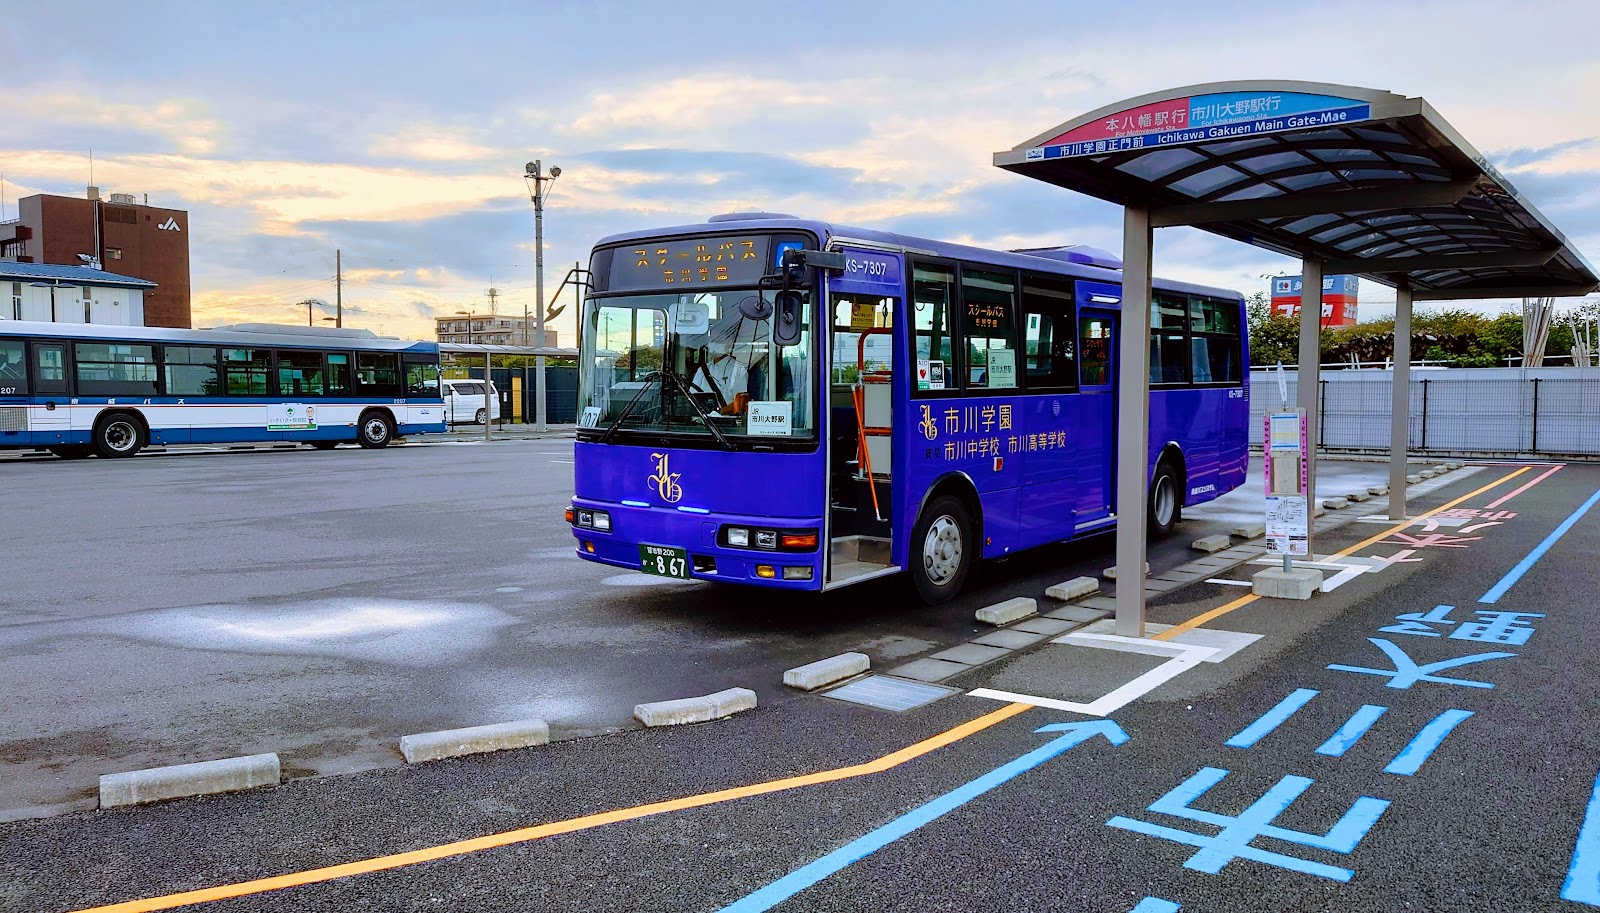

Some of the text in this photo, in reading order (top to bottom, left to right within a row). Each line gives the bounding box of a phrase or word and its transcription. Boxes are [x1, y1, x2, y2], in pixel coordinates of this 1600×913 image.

[1105, 109, 1186, 132] 本八幡駅行
[1191, 95, 1281, 121] 市川大野駅行
[1059, 136, 1144, 156] 市川学園正門前
[1158, 131, 1205, 144] Ichikawa
[1208, 124, 1250, 138] Gakuen
[1254, 118, 1283, 132] Main
[1287, 111, 1347, 126] Gate-Mae
[846, 259, 886, 275] KS-7307
[944, 405, 1012, 435] 市川学園
[944, 430, 1066, 461] 市川中学校 市川高等学校
